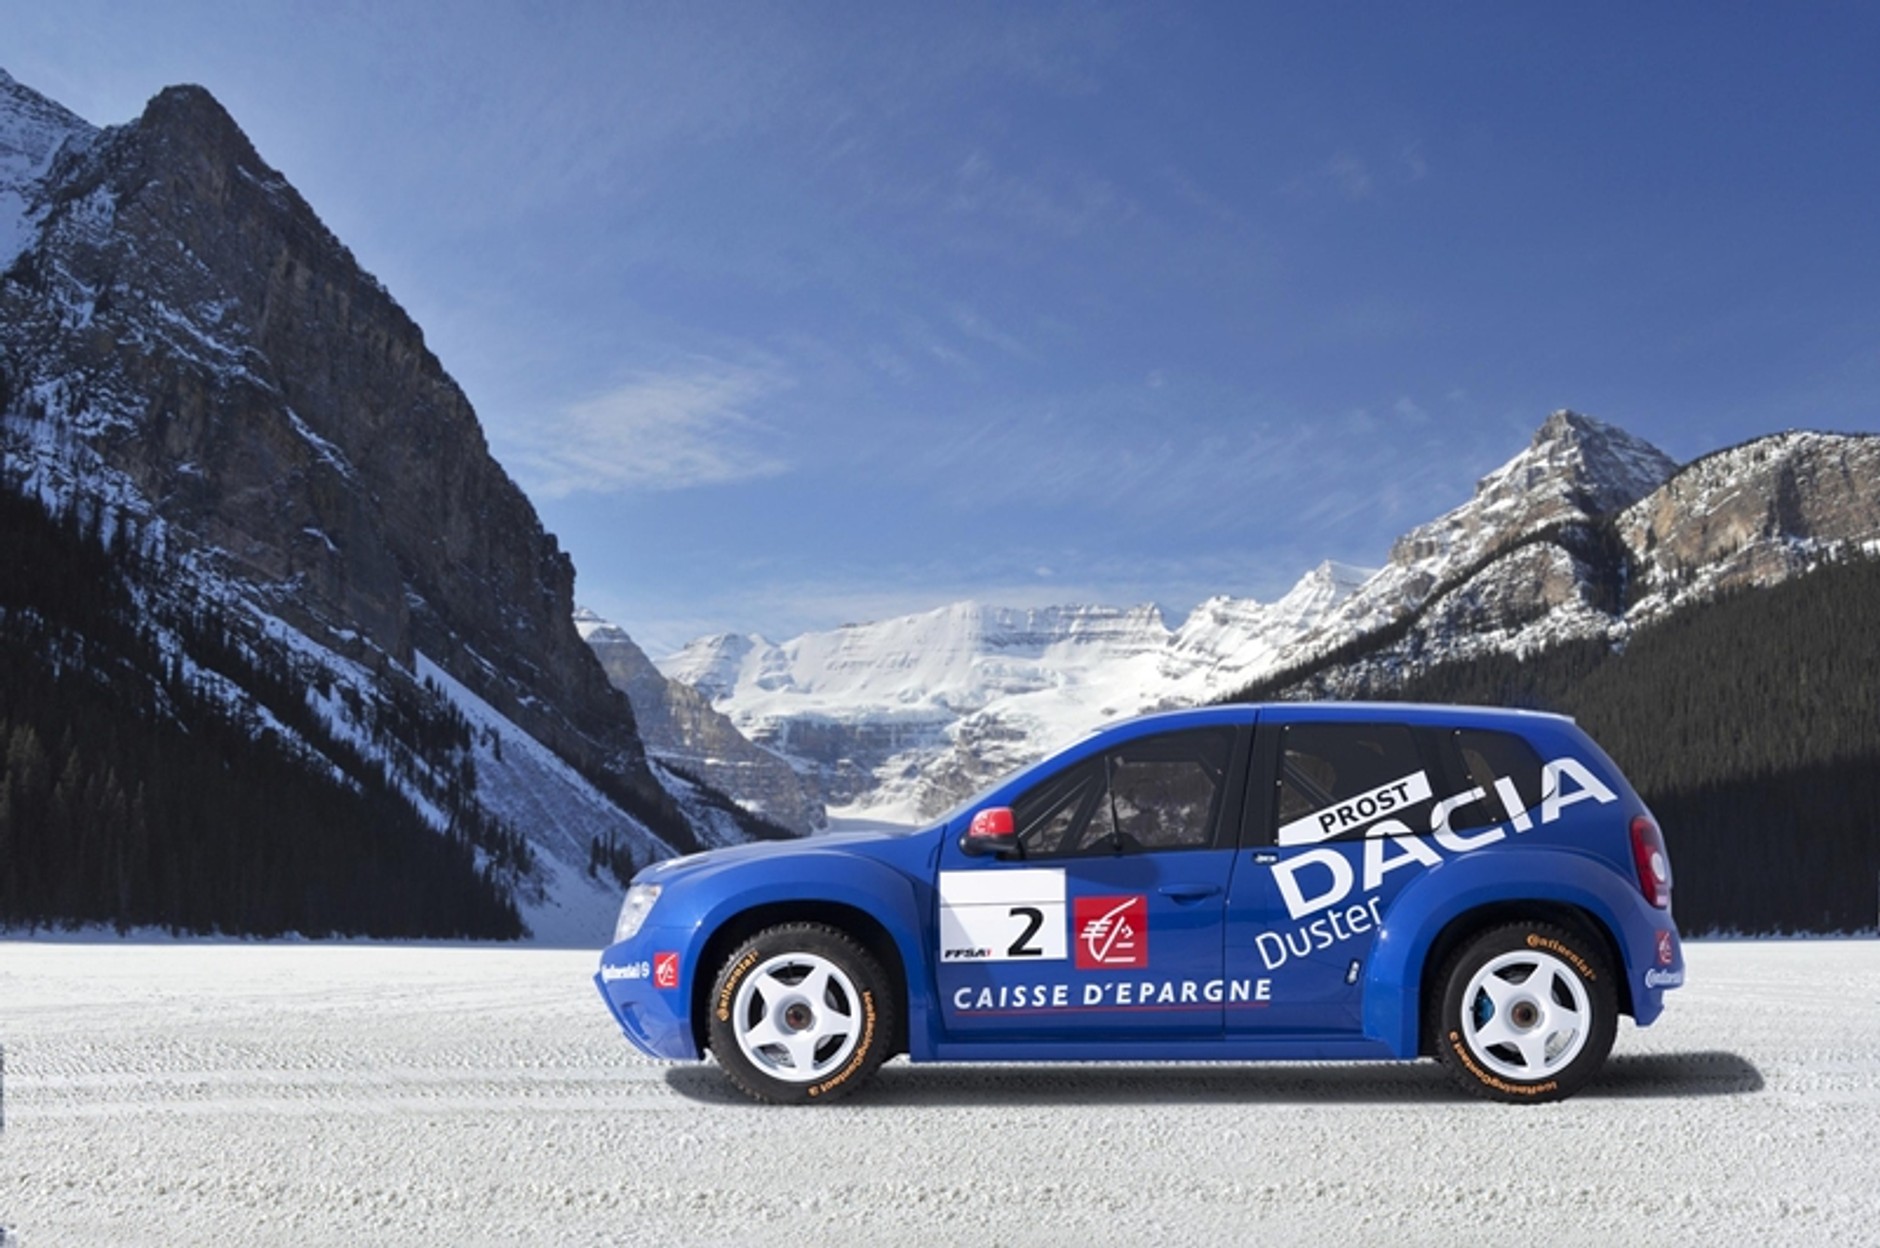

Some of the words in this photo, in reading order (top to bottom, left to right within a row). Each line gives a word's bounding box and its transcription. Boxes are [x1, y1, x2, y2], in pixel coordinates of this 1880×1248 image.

[1317, 781, 1411, 834] PROST
[1271, 757, 1618, 921] DACIA
[1007, 907, 1045, 957] 2
[1254, 896, 1384, 970] Duster
[953, 984, 1069, 1010] CAISSE
